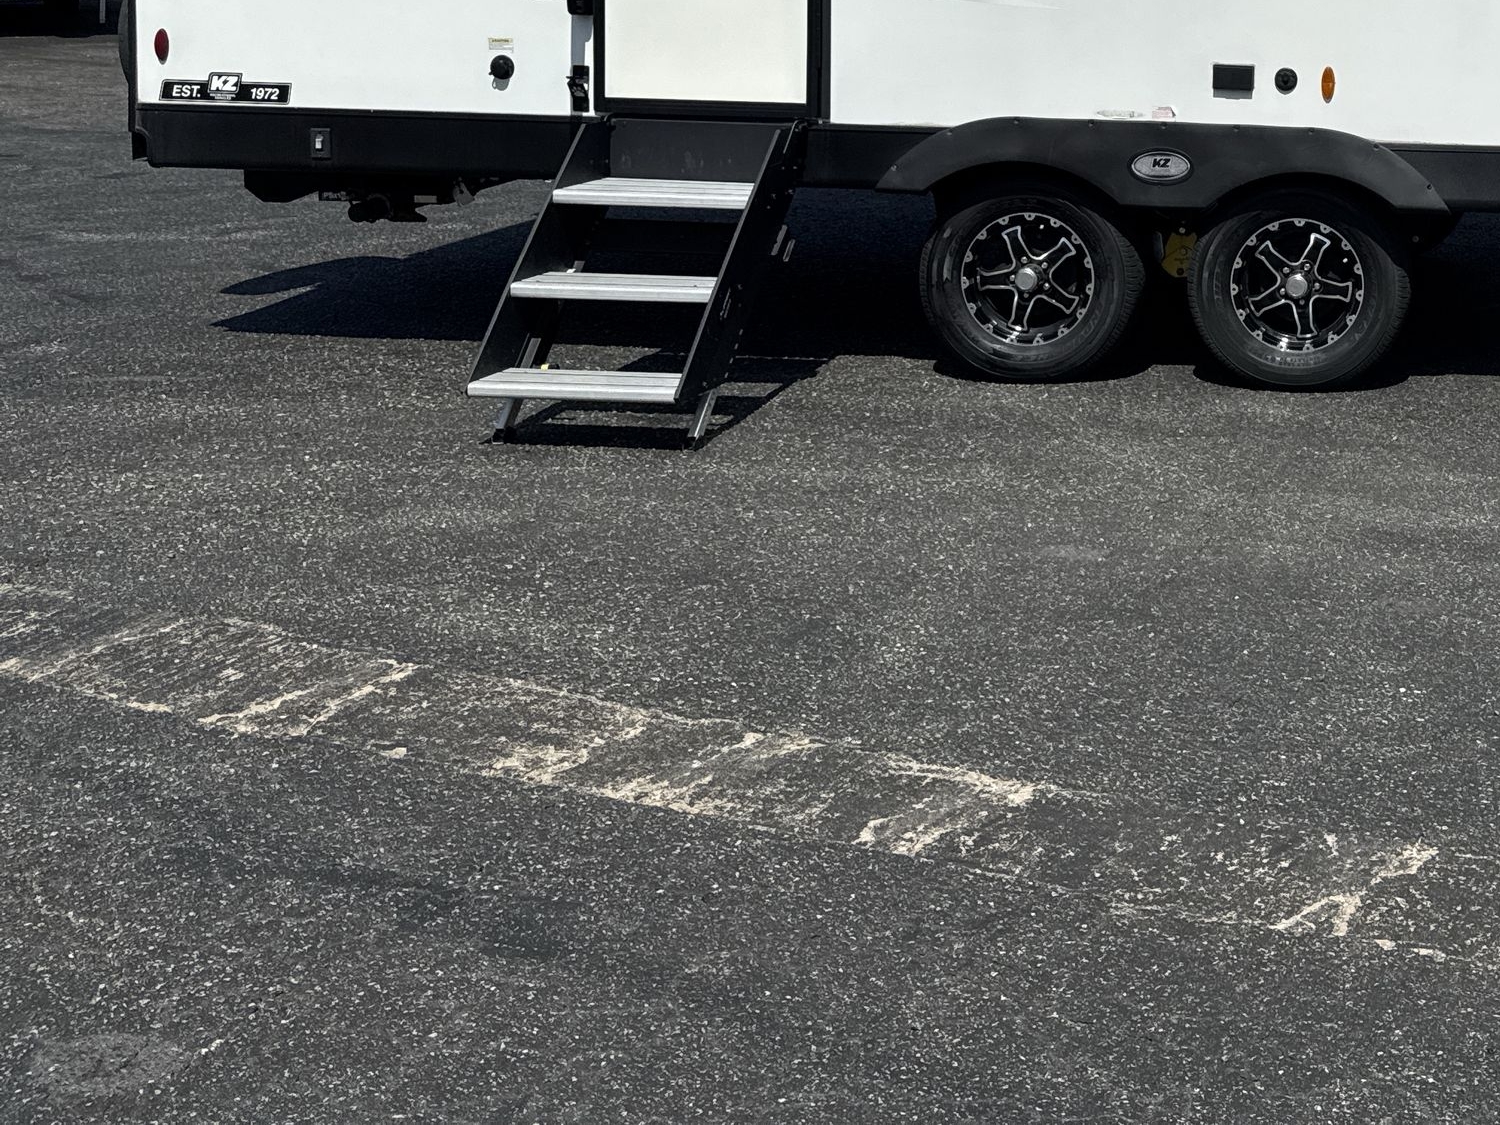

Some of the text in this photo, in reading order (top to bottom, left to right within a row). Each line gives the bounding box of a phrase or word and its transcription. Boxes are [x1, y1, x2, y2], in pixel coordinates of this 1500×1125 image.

[210, 75, 239, 91] KZ
[172, 84, 201, 97] EST.
[250, 87, 280, 100] 1972
[1152, 158, 1171, 168] KZ
